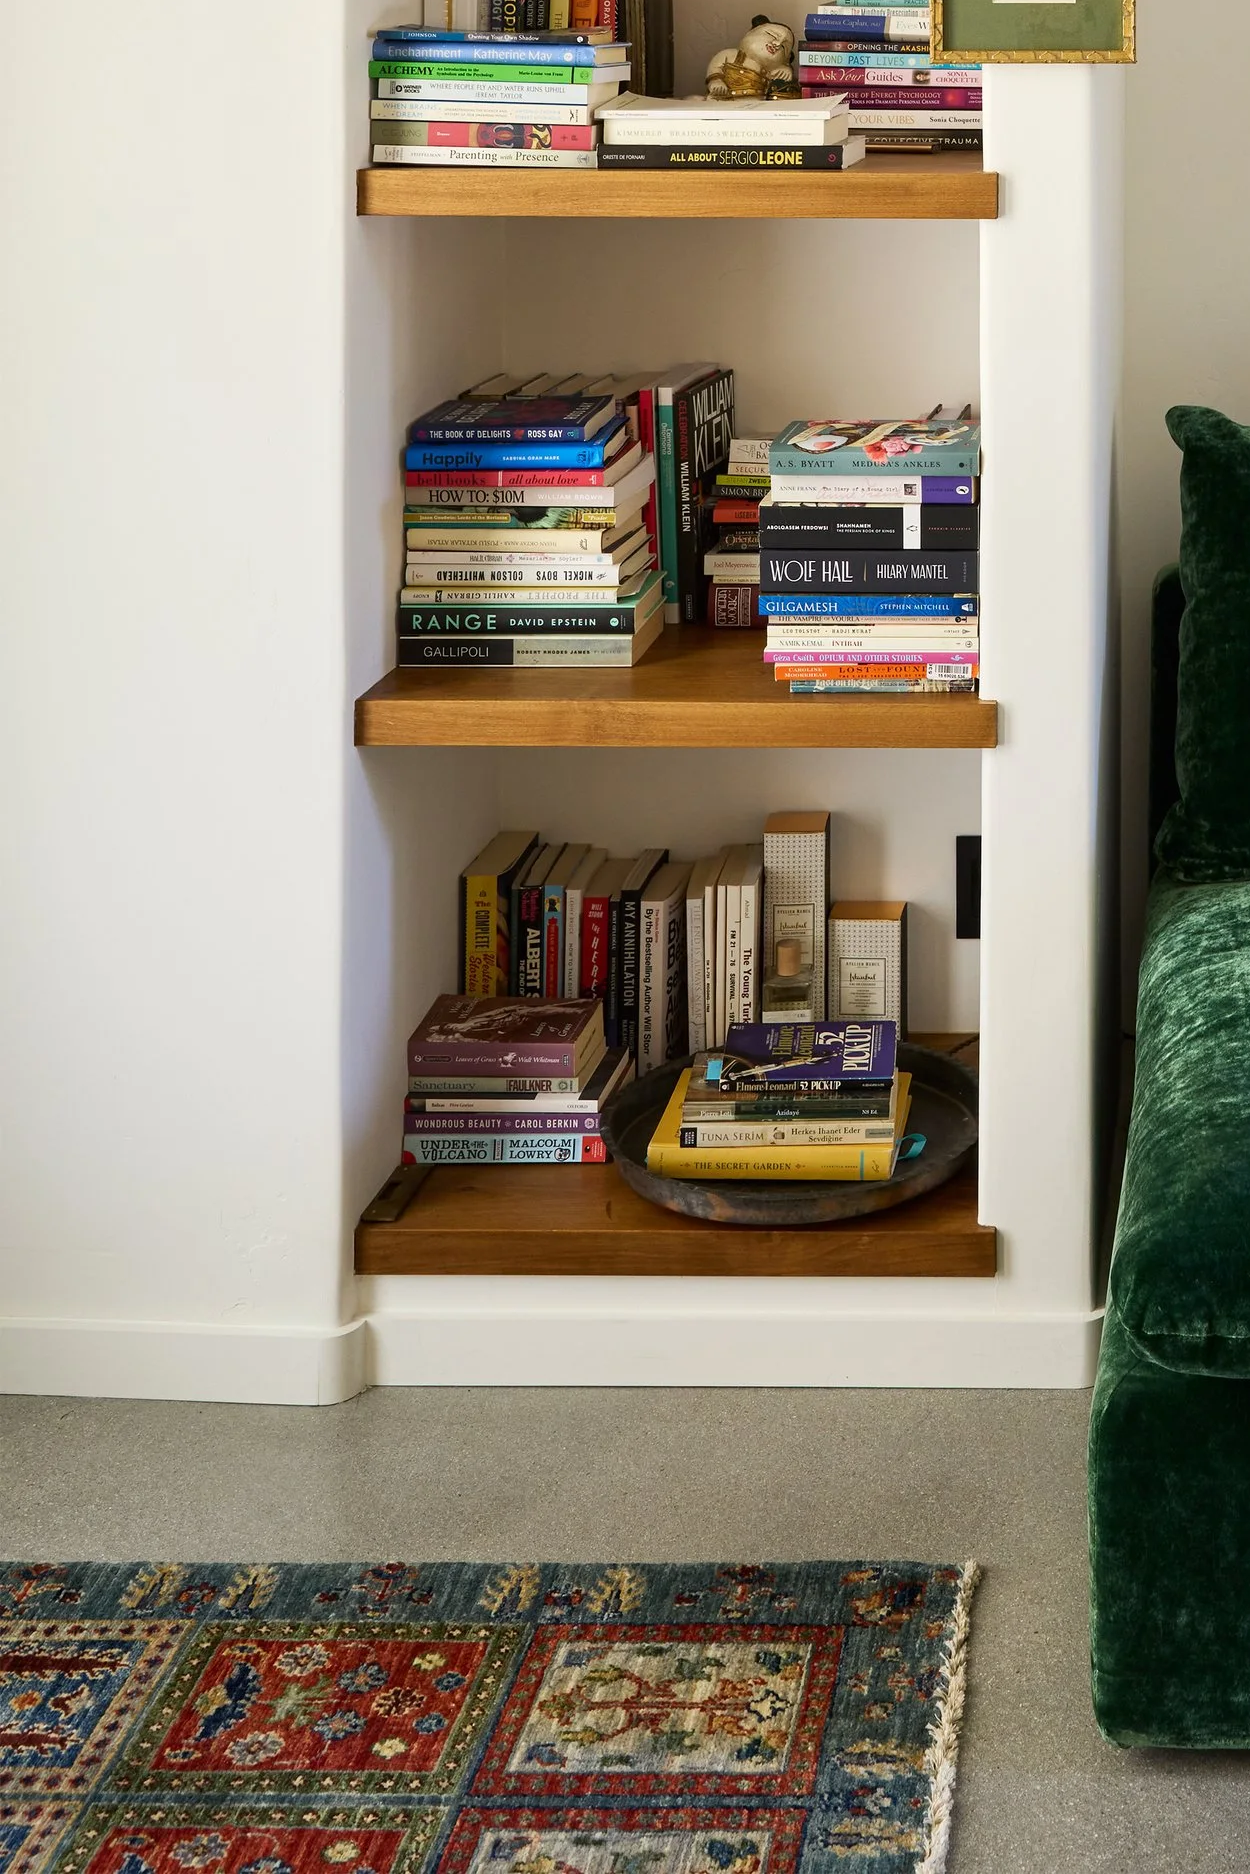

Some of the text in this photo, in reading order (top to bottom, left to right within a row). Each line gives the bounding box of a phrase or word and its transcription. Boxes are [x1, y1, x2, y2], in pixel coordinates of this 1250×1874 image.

[388, 45, 553, 62] Enchantment Katherine May
[808, 54, 904, 66] BEYOND PAST LIVES
[379, 65, 435, 75] ALCHEMY
[816, 70, 837, 80] Ask
[866, 71, 903, 82] Guides
[853, 115, 915, 124] YOUR VIBES
[450, 150, 498, 162] Parenting
[515, 151, 559, 163] Presence
[670, 153, 685, 162] ALL
[687, 153, 717, 162] ABOUT
[693, 375, 734, 427] WILLIAM
[430, 430, 511, 438] THE BOOK OF DELIGHTS
[528, 430, 563, 438] ROSS GAY
[695, 407, 734, 478] KLEIN
[422, 452, 483, 468] Happily
[801, 460, 835, 468] BYATT
[509, 474, 579, 485] all about love
[429, 489, 524, 504] HOW TO: $10M
[680, 462, 690, 531] WILLIAM KLEIN
[437, 571, 523, 581] COLSON WHITEHEAD
[536, 571, 593, 580] NICKEL BOYS
[770, 560, 853, 582] WOLF HALL
[877, 564, 948, 580] HILARY MANTEL
[766, 602, 838, 612] GILGAMESH
[413, 614, 497, 630] RANGE
[510, 618, 596, 626] DAVID EPSTEIN
[424, 647, 489, 657] GALLIPOLI
[475, 910, 490, 949] COMPLETE
[526, 928, 540, 989] ALBERT
[623, 901, 635, 1006] MY ANNIHILATION
[743, 949, 752, 965] The
[643, 908, 653, 1055] By the Bestselling Author Will Storr
[741, 969, 752, 998] Young
[413, 1080, 476, 1091] Sanctuary
[508, 1079, 551, 1091] FAULKNER
[736, 1081, 797, 1091] Elmore Leonard
[800, 1081, 808, 1091] 52
[415, 1119, 501, 1128] WONDROUS BEAUTY
[515, 1119, 578, 1128] CAROL BERKIN
[818, 1126, 841, 1135] İhanet
[701, 1131, 765, 1142] TUNA SERİM
[809, 1134, 842, 1143] Sevdiğine
[420, 1139, 470, 1149] UNDER
[509, 1139, 572, 1148] MALCOLM
[422, 1149, 487, 1160] VOLCANO
[509, 1150, 552, 1159] LOWRY
[694, 1162, 791, 1170] THE SECRET GARDEN
